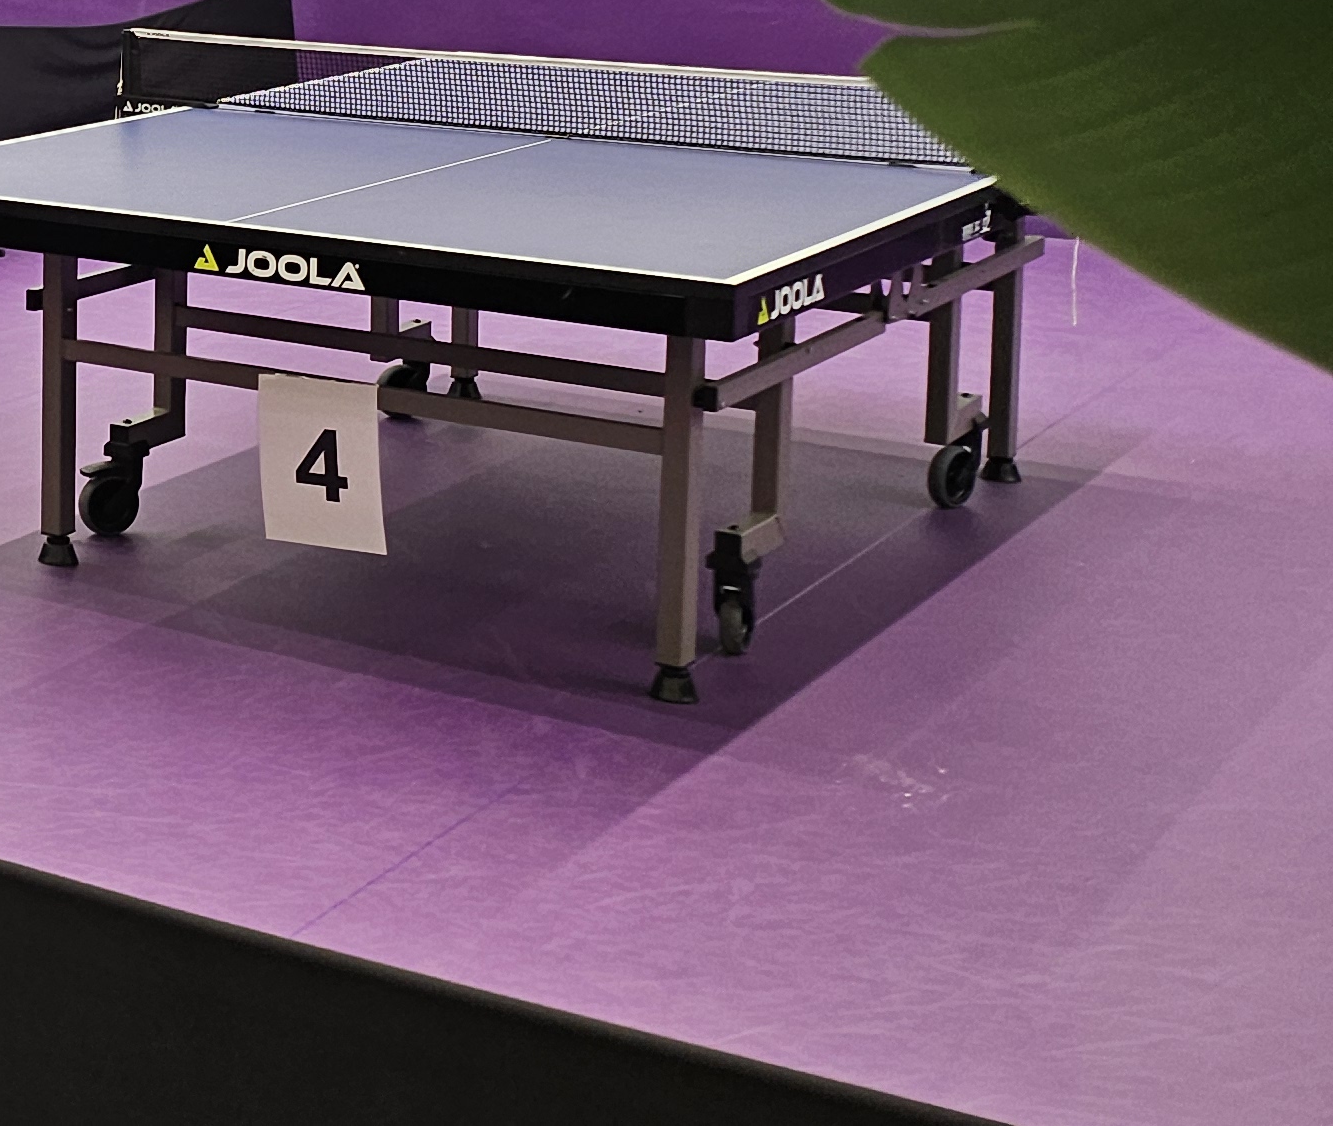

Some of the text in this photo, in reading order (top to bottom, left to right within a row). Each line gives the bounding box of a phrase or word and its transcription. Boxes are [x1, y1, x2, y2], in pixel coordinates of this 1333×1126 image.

[225, 249, 365, 290] JOOLA
[770, 273, 825, 320] JOOLA
[295, 429, 349, 502] 4
